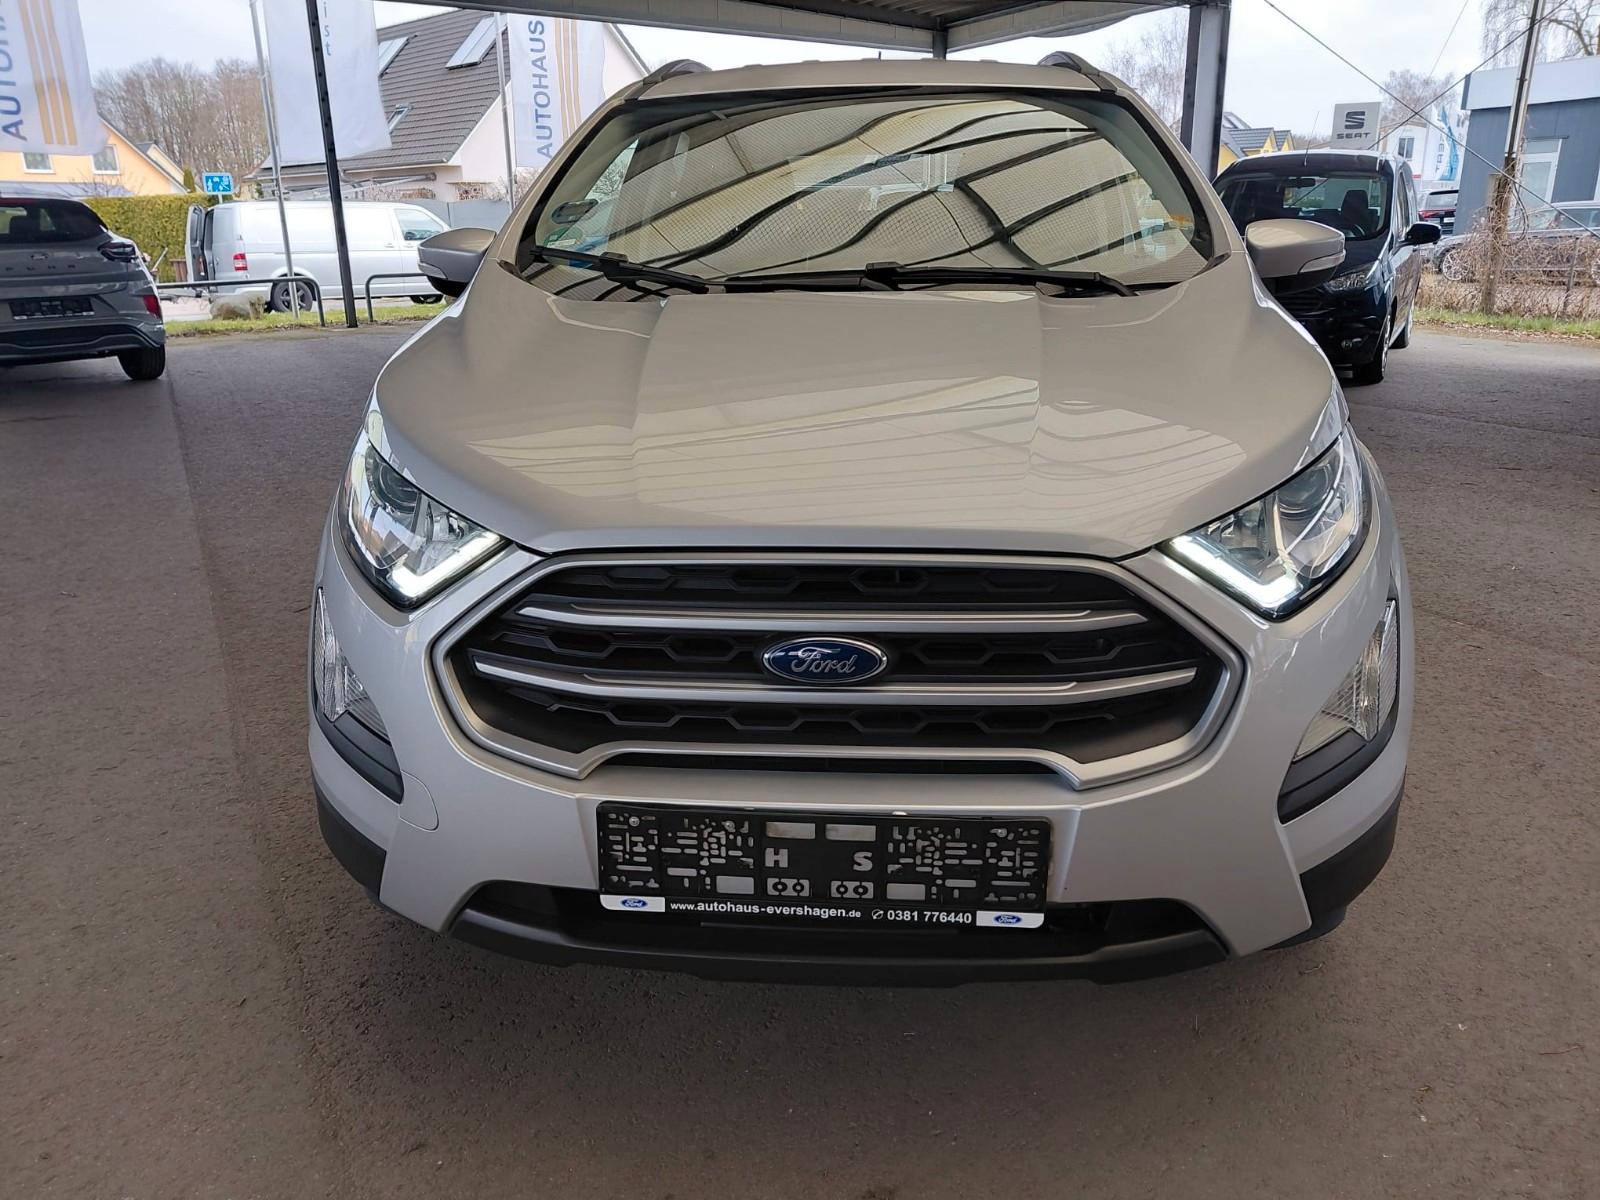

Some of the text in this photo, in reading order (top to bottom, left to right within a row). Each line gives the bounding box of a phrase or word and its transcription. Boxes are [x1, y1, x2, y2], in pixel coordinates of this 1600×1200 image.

[528, 20, 552, 159] AUTOHAUS
[789, 646, 858, 674] Ford
[765, 848, 789, 868] H
[853, 851, 873, 871] S
[623, 899, 645, 908] Ford
[670, 901, 972, 924] www.autohaus-evershagen.de 0381 776440
[998, 914, 1019, 924] Ford
